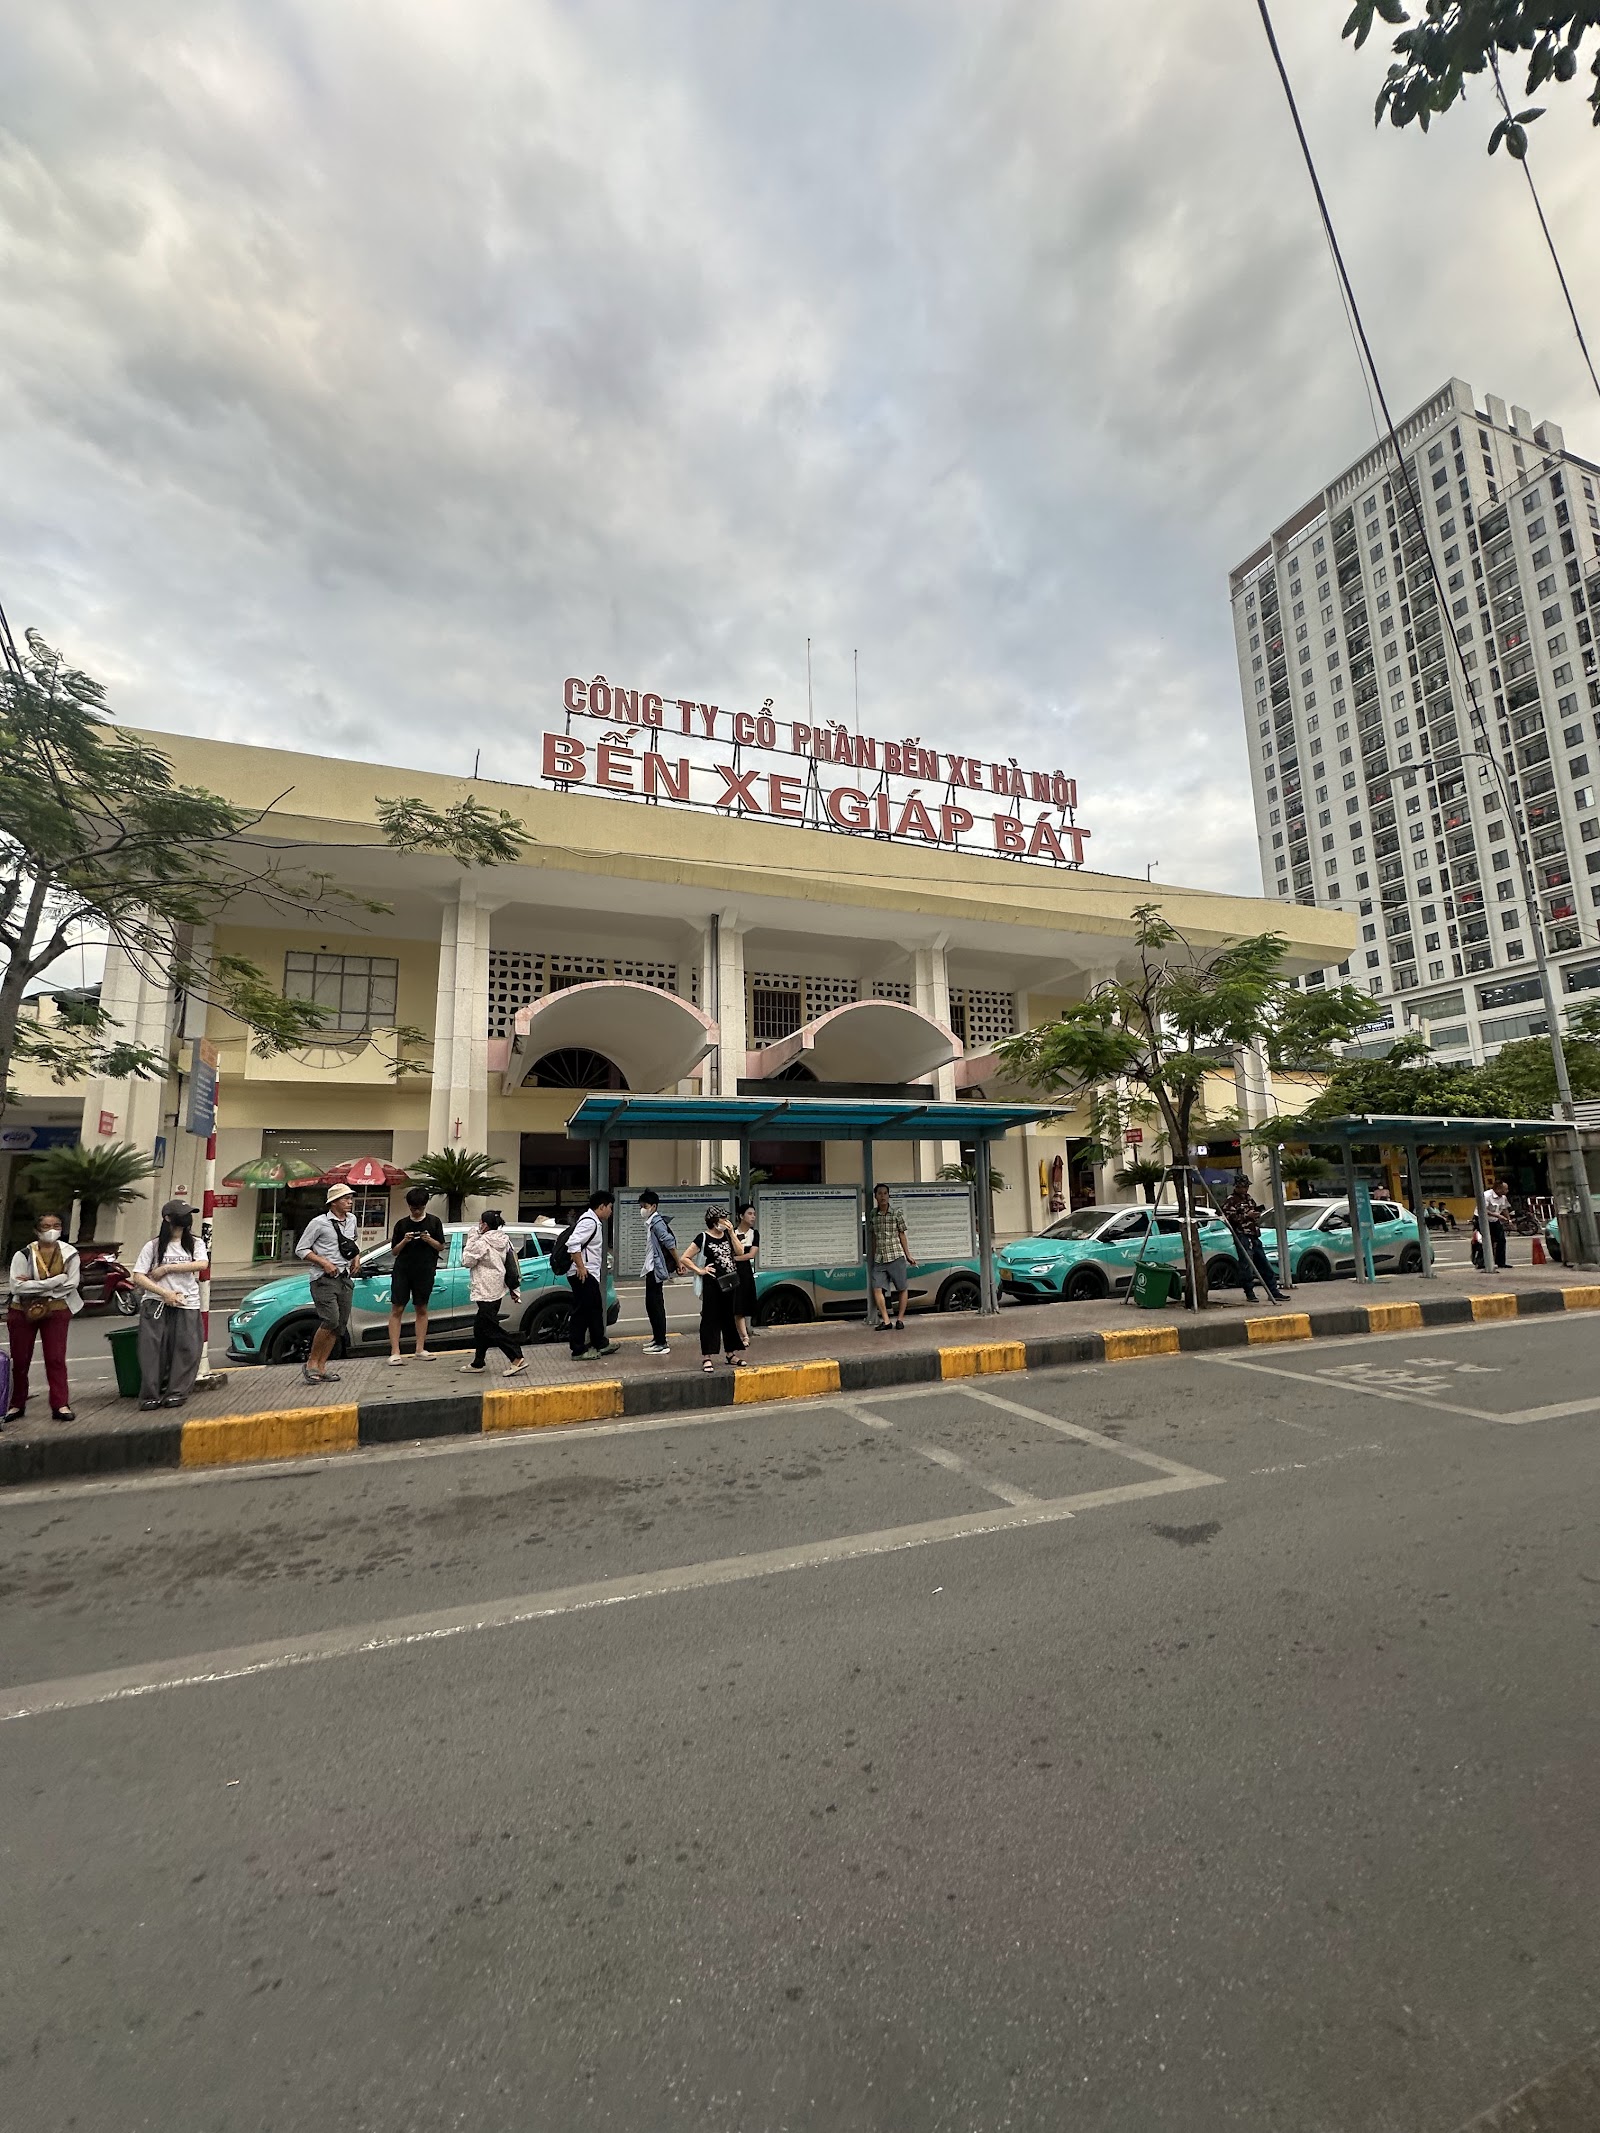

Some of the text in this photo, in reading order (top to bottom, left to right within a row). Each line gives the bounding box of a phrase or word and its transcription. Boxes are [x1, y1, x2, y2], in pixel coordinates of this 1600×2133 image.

[542, 727, 1091, 864] BẾN XE GIÁP BÁT
[563, 674, 1078, 812] CÔNG TY CỔ PHẦN BẾN XE HÀ NỘI
